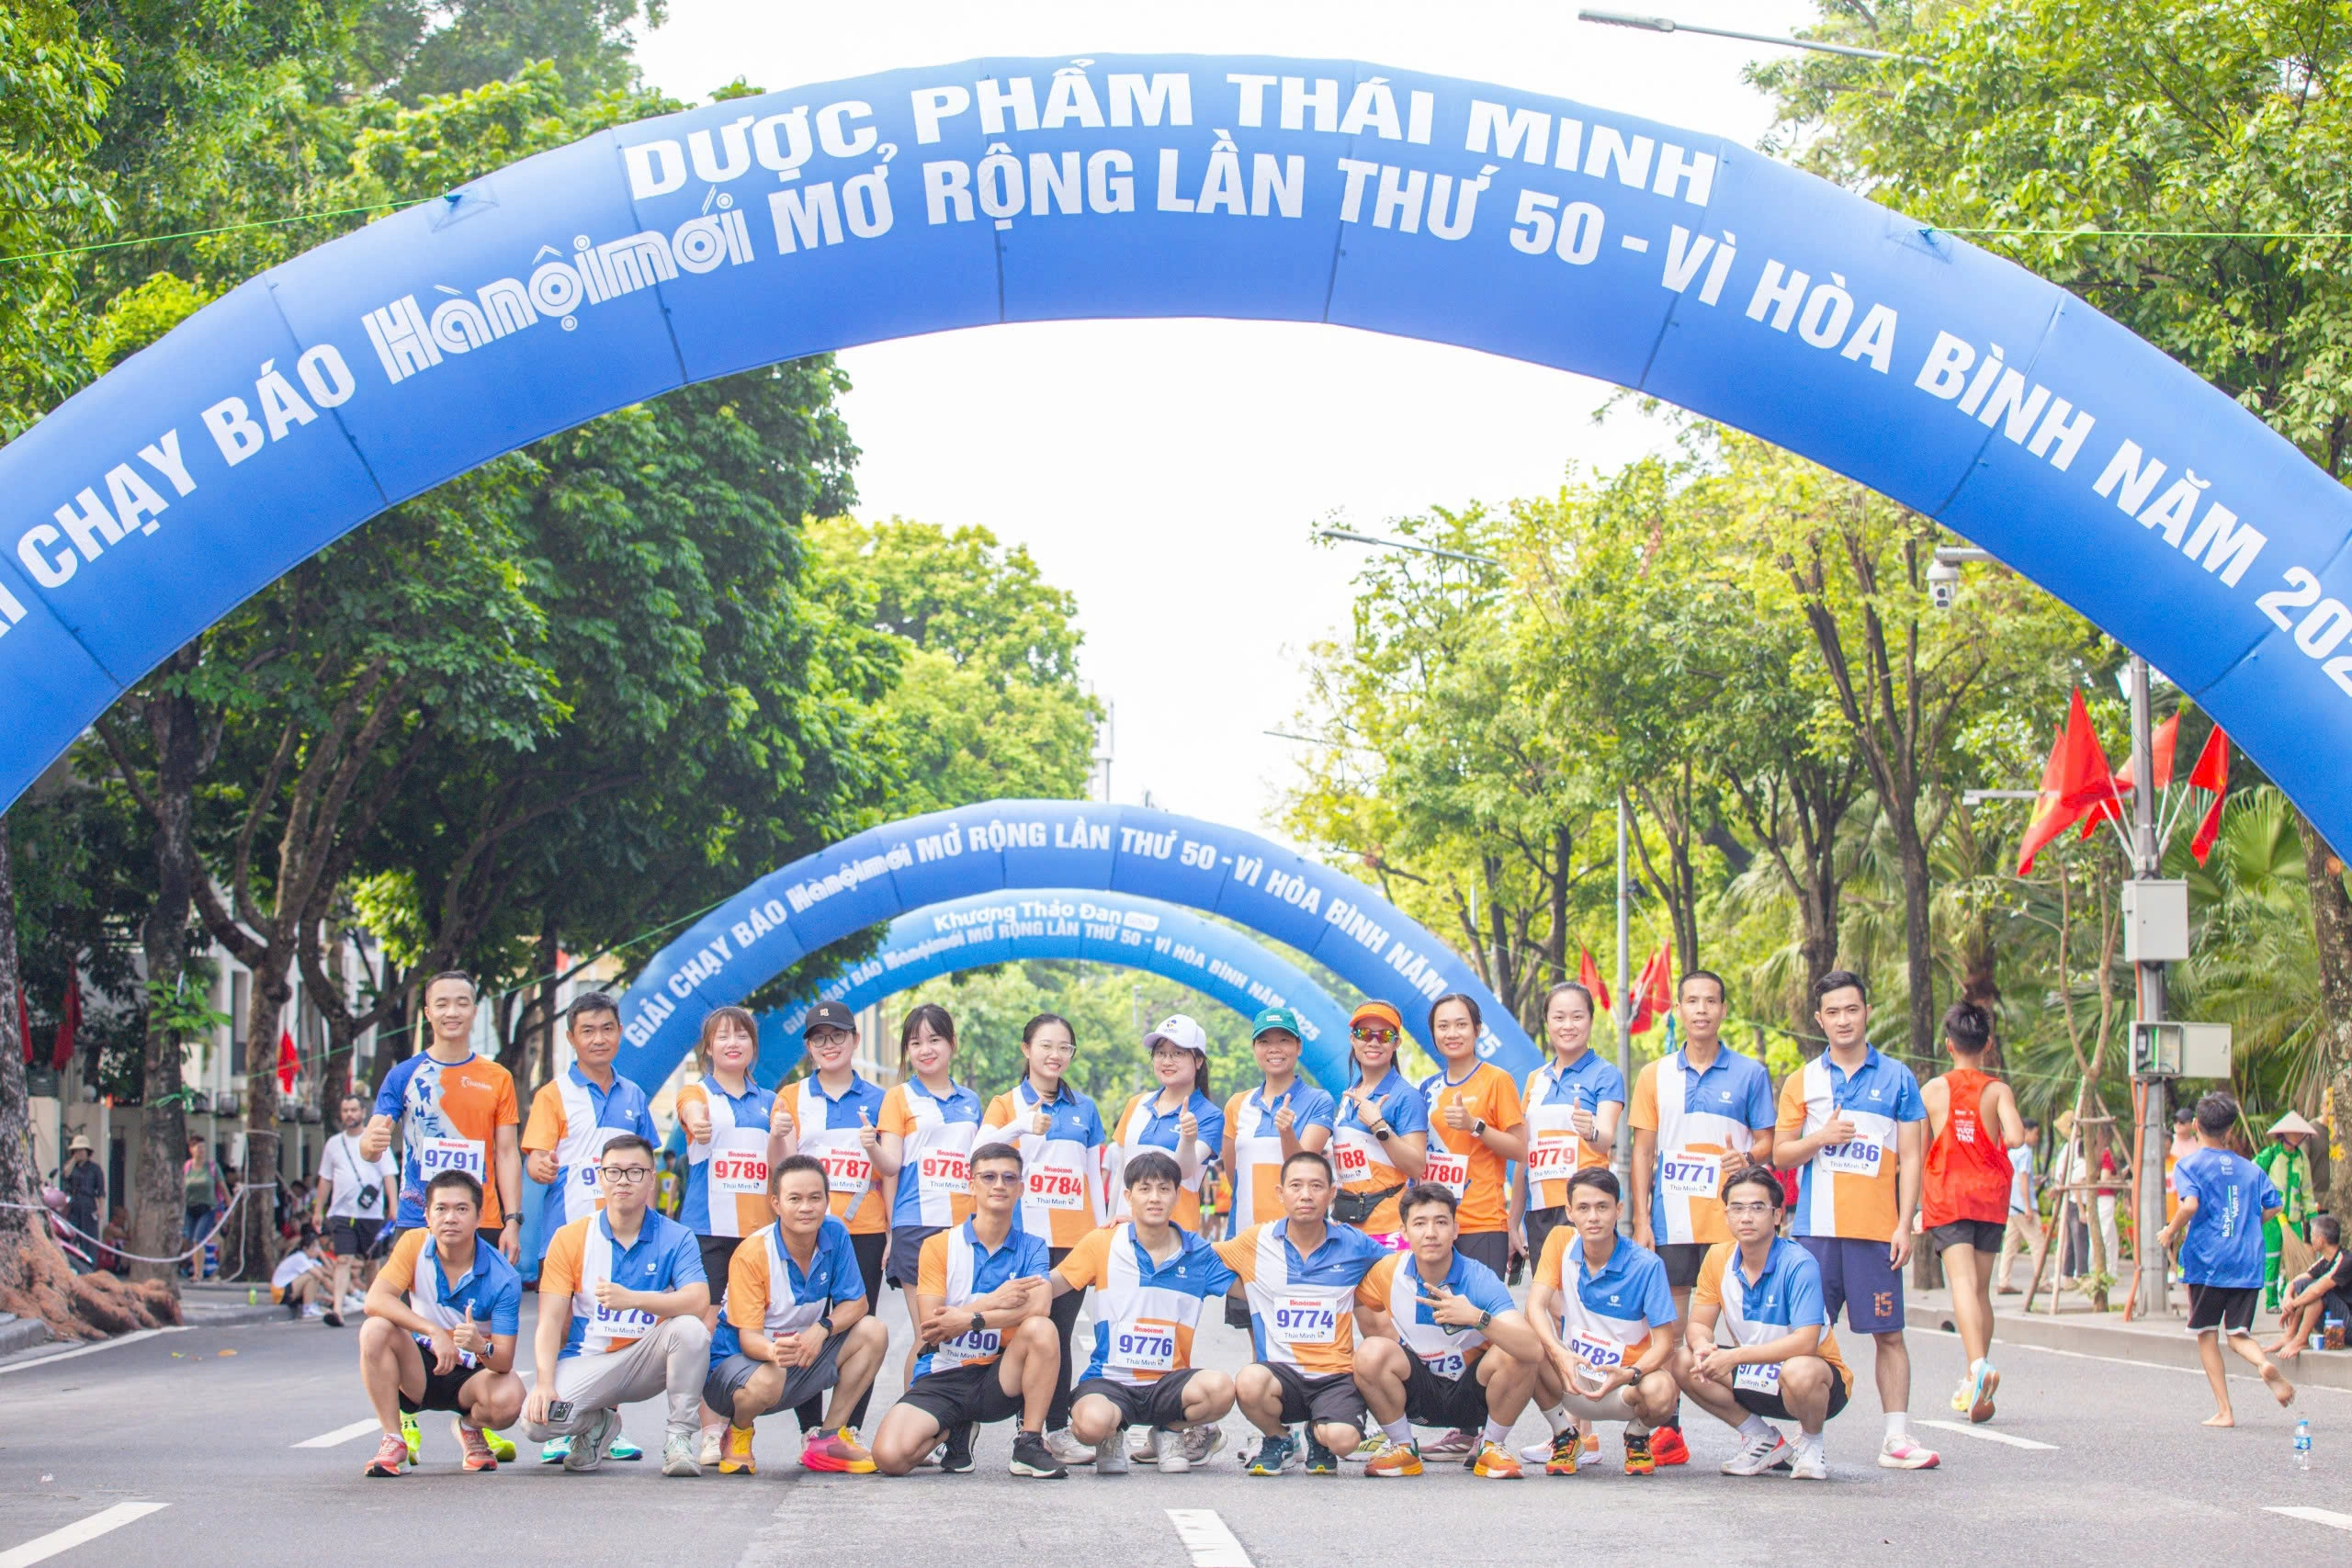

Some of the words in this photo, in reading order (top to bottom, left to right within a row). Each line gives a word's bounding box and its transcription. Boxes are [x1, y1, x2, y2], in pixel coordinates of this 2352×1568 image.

[622, 100, 877, 200] DƯỢC
[911, 58, 1193, 144] PHẨM
[1227, 76, 1433, 144] THÁI
[1465, 99, 1718, 207] MINH
[17, 429, 197, 589] CHẠY
[201, 344, 356, 467] BÁO
[768, 142, 898, 255] MỞ
[922, 142, 1135, 231] RỘNG
[1158, 129, 1305, 219] LẦN
[1338, 158, 1500, 241] THỨ
[1509, 189, 1605, 265] 50
[1621, 234, 1648, 254] -
[1661, 224, 1736, 307] VÌ
[1746, 259, 1898, 375] HÒA
[1914, 330, 2095, 472] BÌNH
[2092, 438, 2268, 589] NĂM
[933, 906, 1014, 931] Khương
[1019, 900, 1075, 918] Thảo
[1080, 903, 1122, 924] Đan
[624, 992, 676, 1048] GIẢI
[668, 935, 733, 998] CHẠY
[731, 899, 787, 948] BÁO
[915, 822, 963, 863] MỞ
[968, 819, 1046, 852] RỘNG
[1056, 816, 1110, 850] LẦN
[1120, 828, 1179, 860] THỨ
[1180, 840, 1216, 870] 50
[1234, 855, 1263, 887] VÌ
[1265, 869, 1321, 915] HÒA
[1324, 898, 1390, 953] BÌNH
[1385, 941, 1448, 1001] NĂM
[1477, 1021, 1502, 1058] 25
[850, 961, 883, 987] BÁO
[967, 921, 993, 943] MỞ
[999, 919, 1043, 940] RỘNG
[1047, 919, 1079, 936] LẦN
[1085, 923, 1118, 941] THỨ
[1120, 930, 1141, 947] 50
[1154, 936, 1171, 954] VÌ
[1172, 942, 1205, 969] HÒA
[1207, 958, 1248, 989] BÌNH
[1248, 980, 1285, 1009] NĂM
[424, 1149, 478, 1170] 9791
[1334, 1149, 1366, 1169] 788
[1529, 1147, 1575, 1168] 9779
[1824, 1142, 1880, 1163] 9786
[715, 1160, 766, 1180] 9789
[922, 1158, 972, 1181] 9783
[1664, 1162, 1714, 1184] 9771
[1030, 1174, 1082, 1196] 9784
[1873, 1292, 1893, 1317] 15
[1277, 1309, 1333, 1328] 9774
[944, 1330, 998, 1351] 790
[1119, 1335, 1172, 1357] 9776
[1572, 1338, 1620, 1366] 9782
